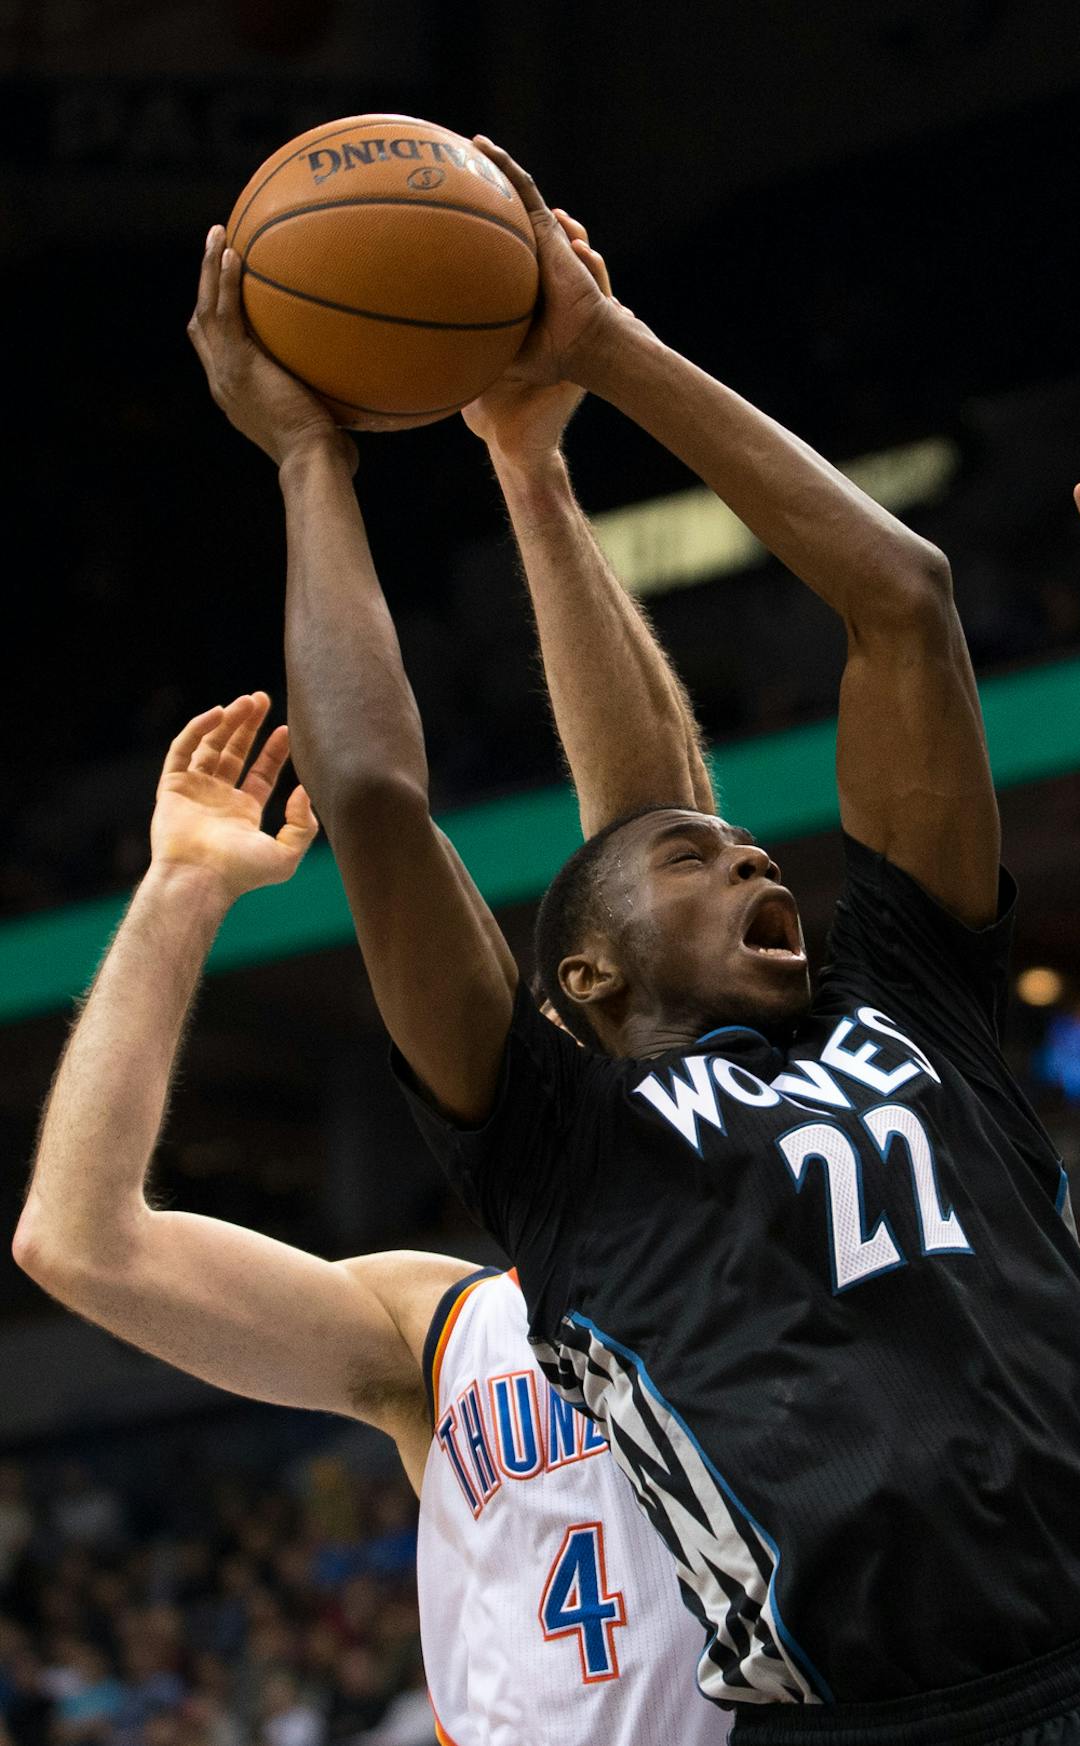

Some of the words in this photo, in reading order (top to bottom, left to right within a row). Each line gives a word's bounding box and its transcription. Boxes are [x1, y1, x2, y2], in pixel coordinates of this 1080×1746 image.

[631, 1005, 943, 1160] WOVES
[774, 1101, 976, 1296] 22
[538, 1520, 627, 1685] 4
